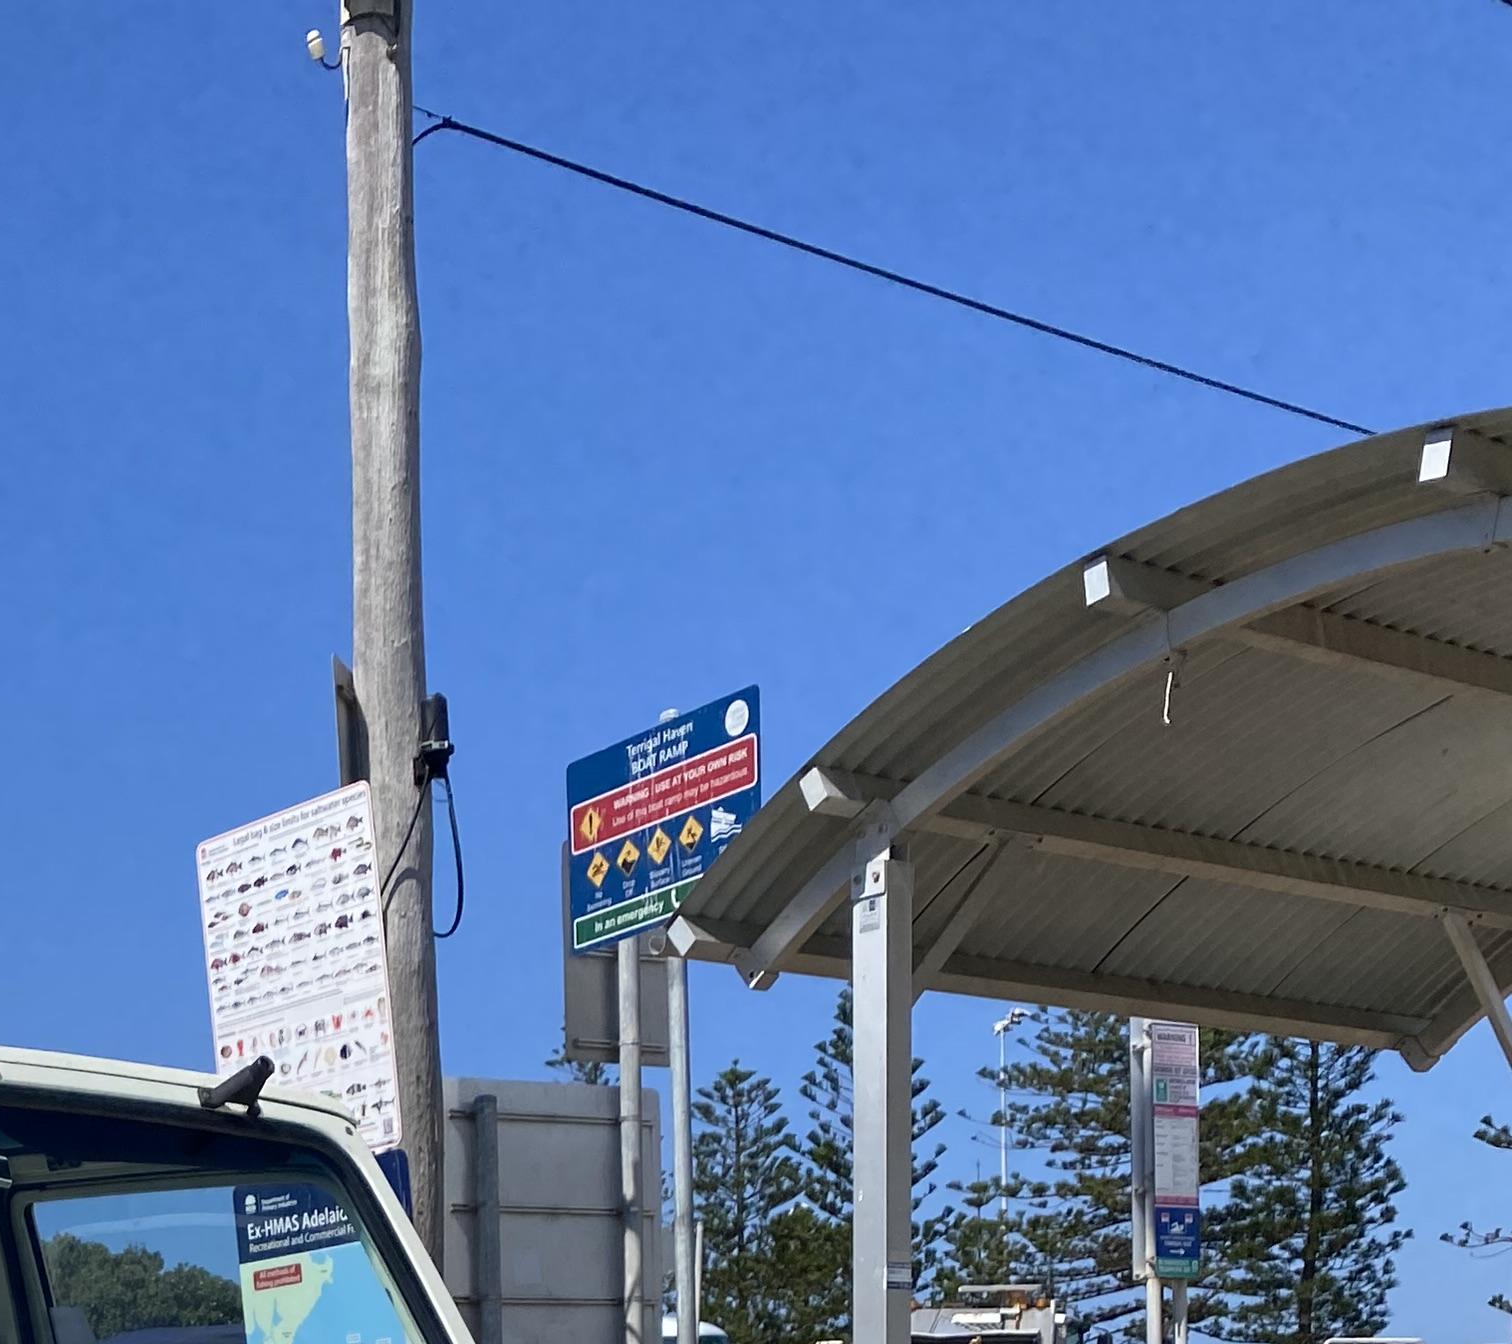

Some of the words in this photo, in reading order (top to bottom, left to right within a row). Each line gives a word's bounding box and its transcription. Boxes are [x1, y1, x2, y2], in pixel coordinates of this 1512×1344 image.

[626, 733, 661, 757] Terrigal
[663, 721, 693, 741] Haven
[632, 752, 657, 775] BOAT
[659, 741, 688, 763] RAMP
[248, 1214, 299, 1240] Ex-HMAS
[249, 1236, 289, 1253] Recreational
[291, 1233, 304, 1246] and
[304, 1224, 346, 1243] Commercial
